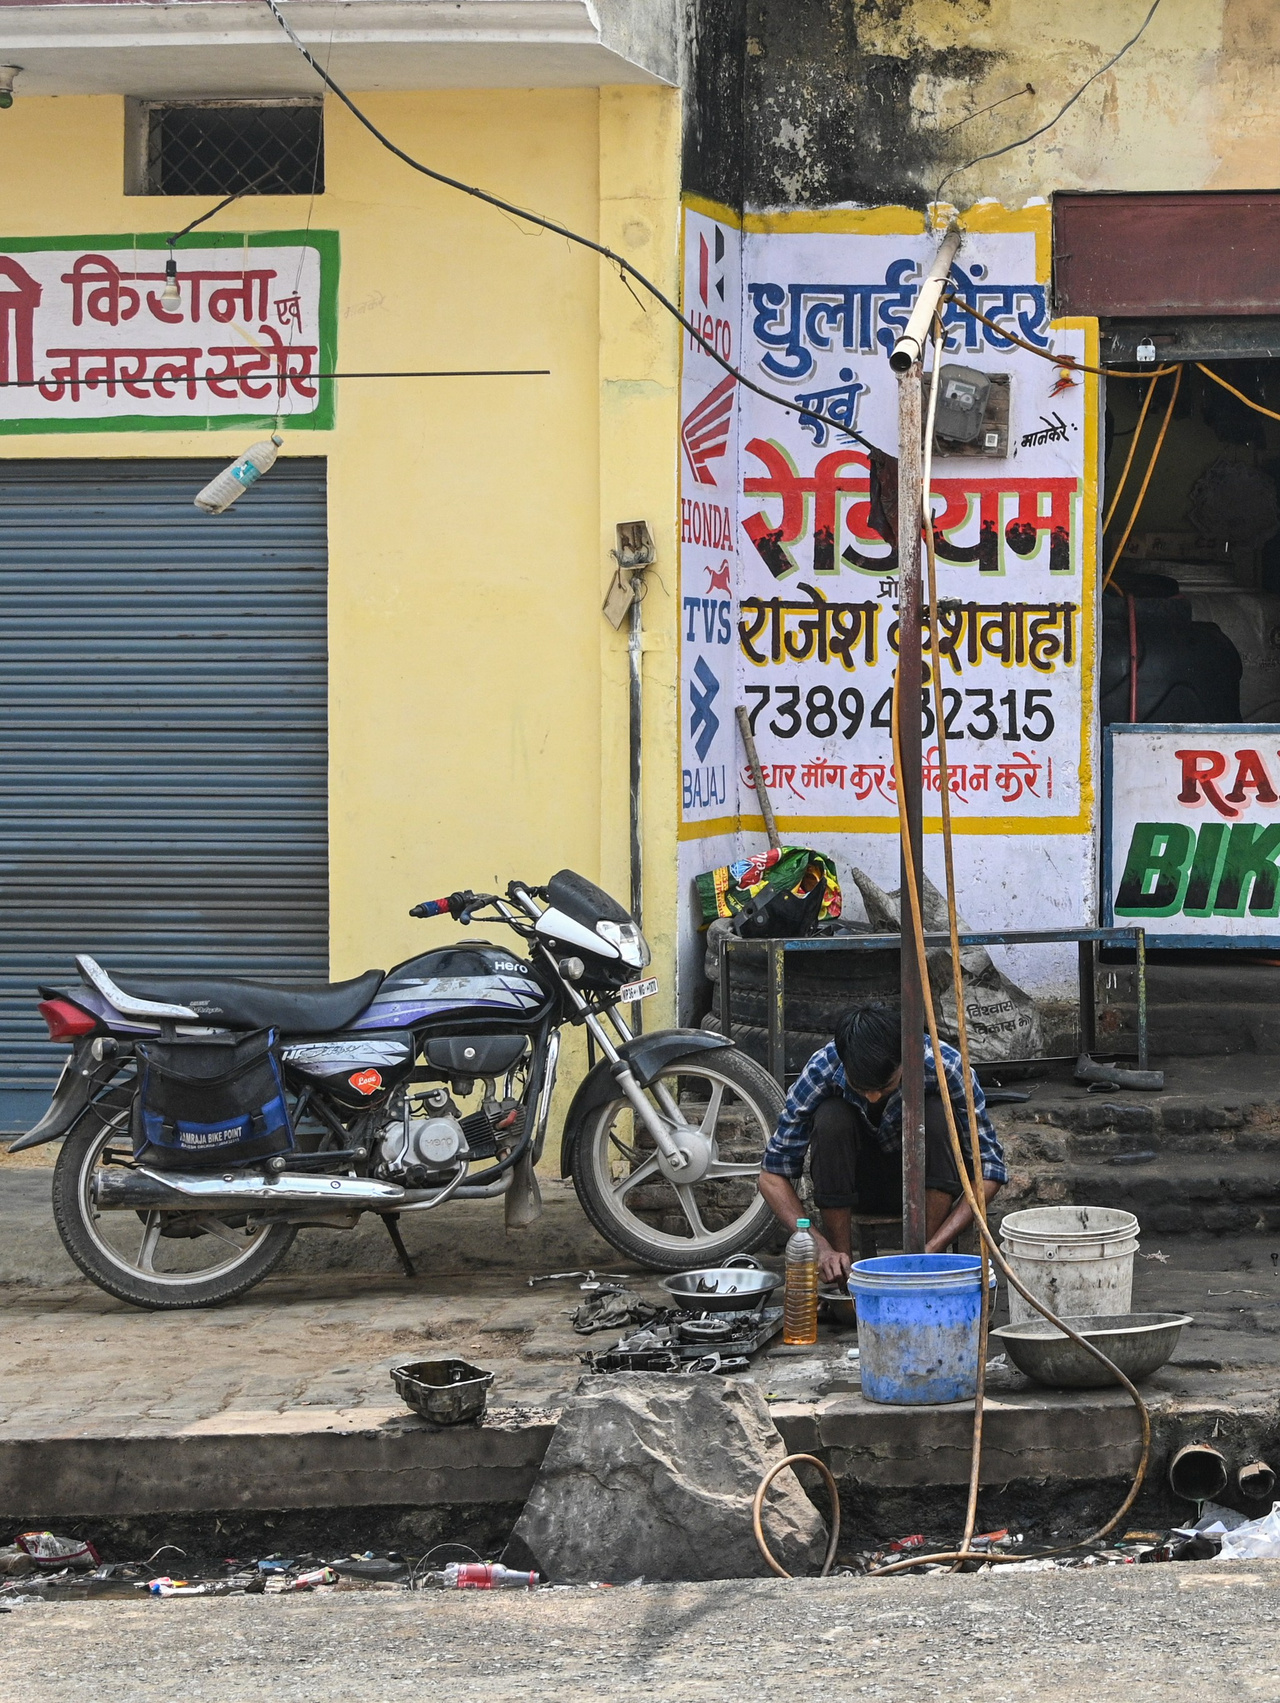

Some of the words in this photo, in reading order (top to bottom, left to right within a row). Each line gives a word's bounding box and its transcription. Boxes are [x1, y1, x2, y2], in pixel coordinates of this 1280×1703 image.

[61, 254, 277, 326] किराना
[689, 309, 733, 362] Hero
[38, 347, 203, 402] जनरल
[205, 325, 318, 400] स्टोर
[794, 367, 868, 447] एवं
[681, 498, 733, 551] HONDA
[684, 596, 731, 645] TVS
[737, 583, 878, 672] राजेश
[682, 764, 726, 810] BAJAJ
[741, 763, 805, 801] उधार
[801, 756, 848, 790] माँग
[850, 764, 896, 804] कर
[972, 764, 993, 792] न
[494, 961, 529, 974] Hero
[966, 1000, 1015, 1019] विश्वास
[972, 1019, 1017, 1035] विकास
[358, 1075, 377, 1086] Love
[207, 1131, 223, 1143] BIKE
[223, 1126, 242, 1141] POINT
[425, 1137, 453, 1148] Hero
